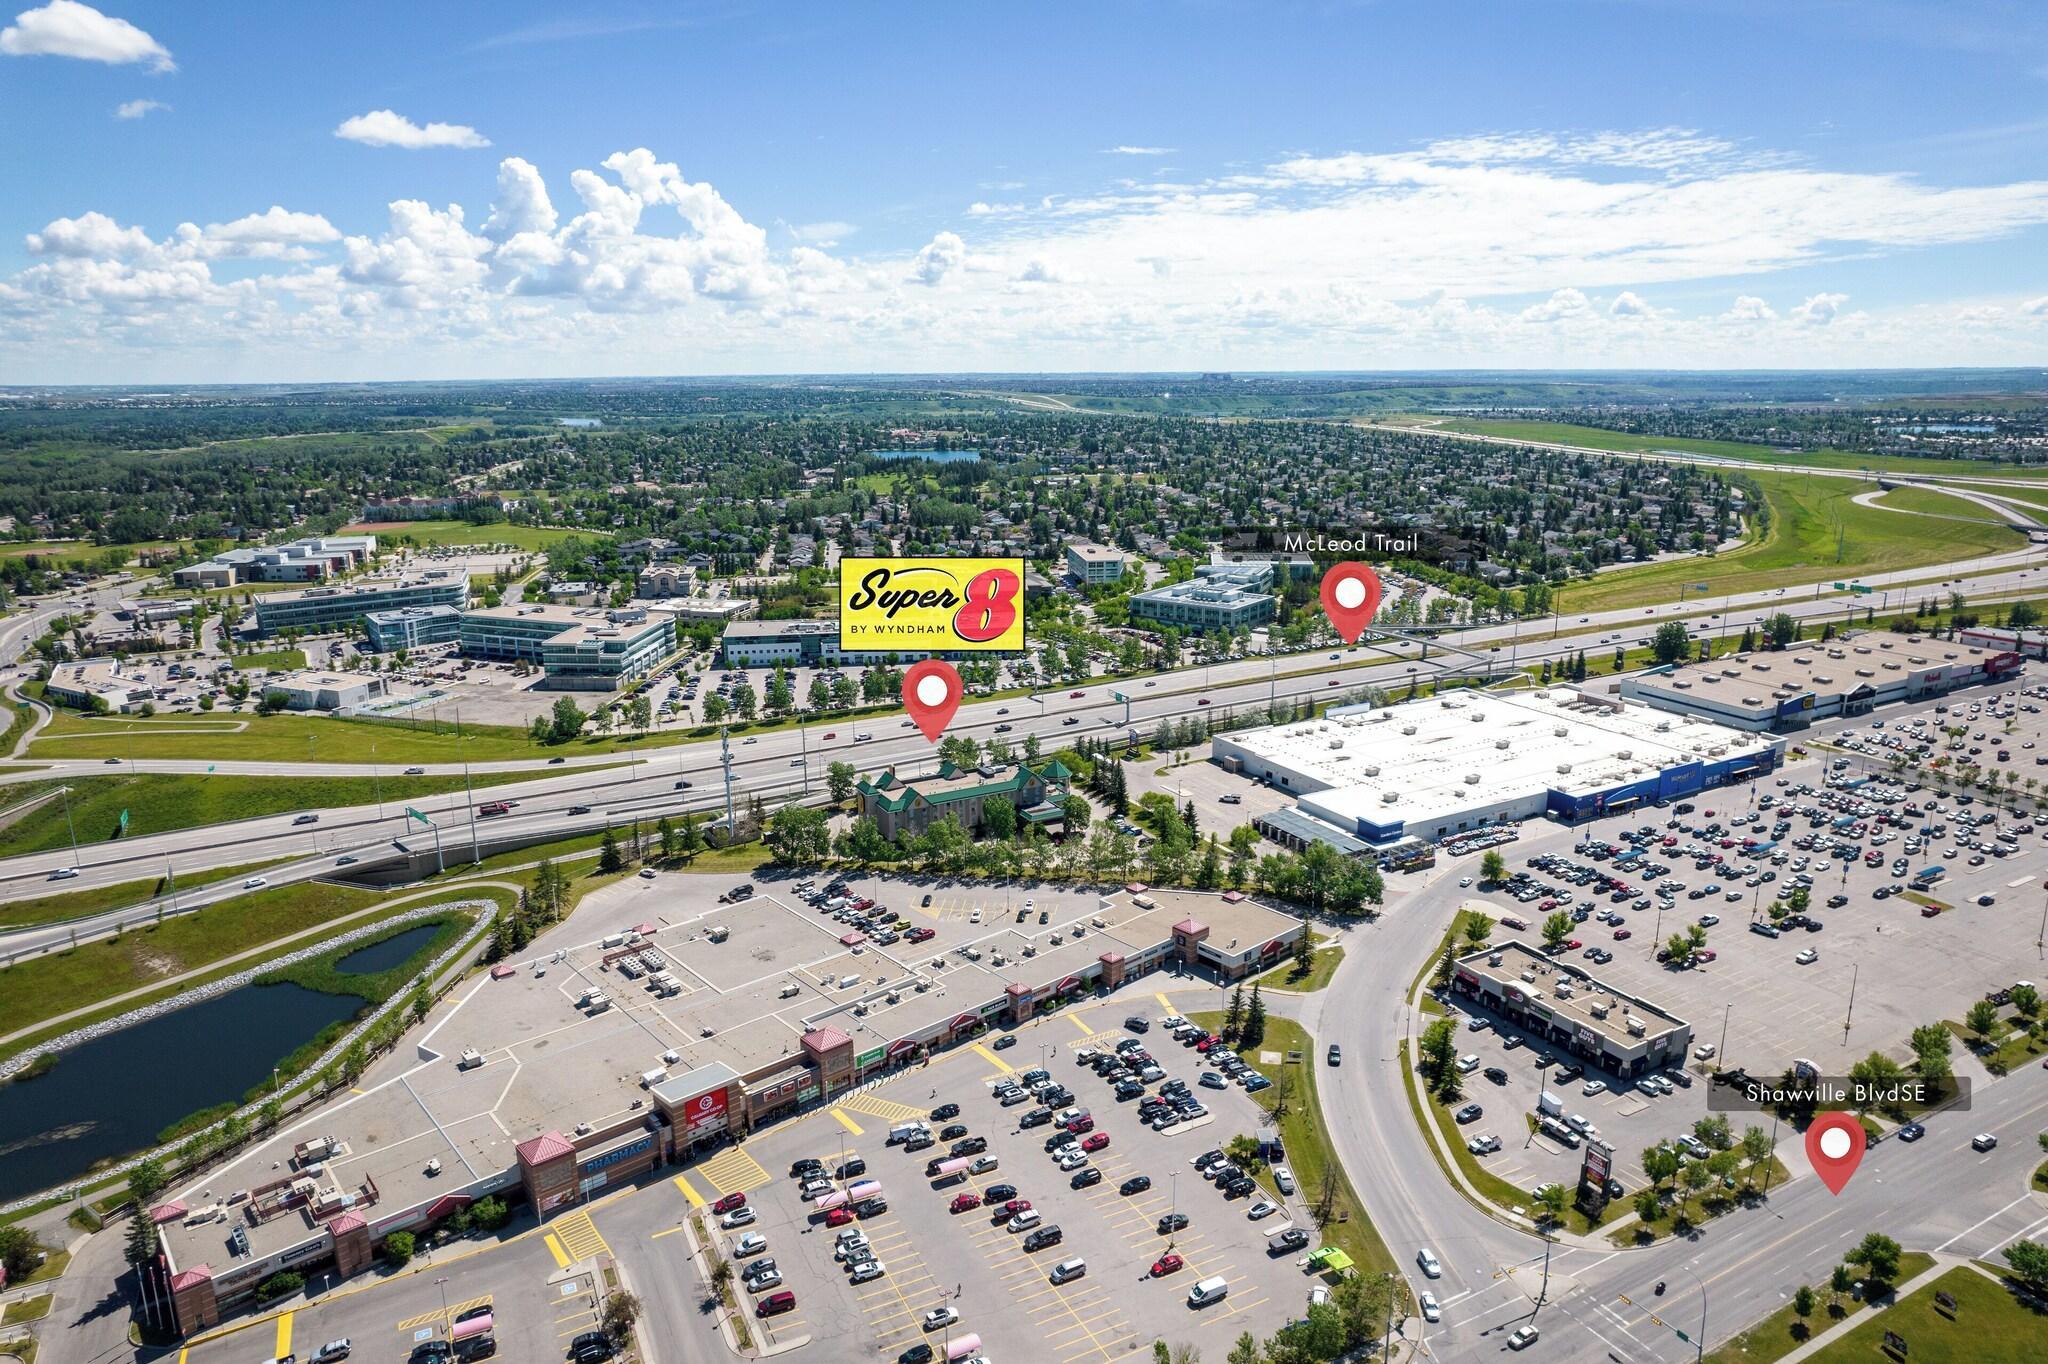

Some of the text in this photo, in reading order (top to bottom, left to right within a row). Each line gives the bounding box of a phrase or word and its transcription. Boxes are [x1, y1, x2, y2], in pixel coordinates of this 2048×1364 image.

[1578, 1032, 1595, 1045] GUYS
[1580, 1028, 1594, 1039] FIVE
[586, 1139, 653, 1173] PHARMACY
